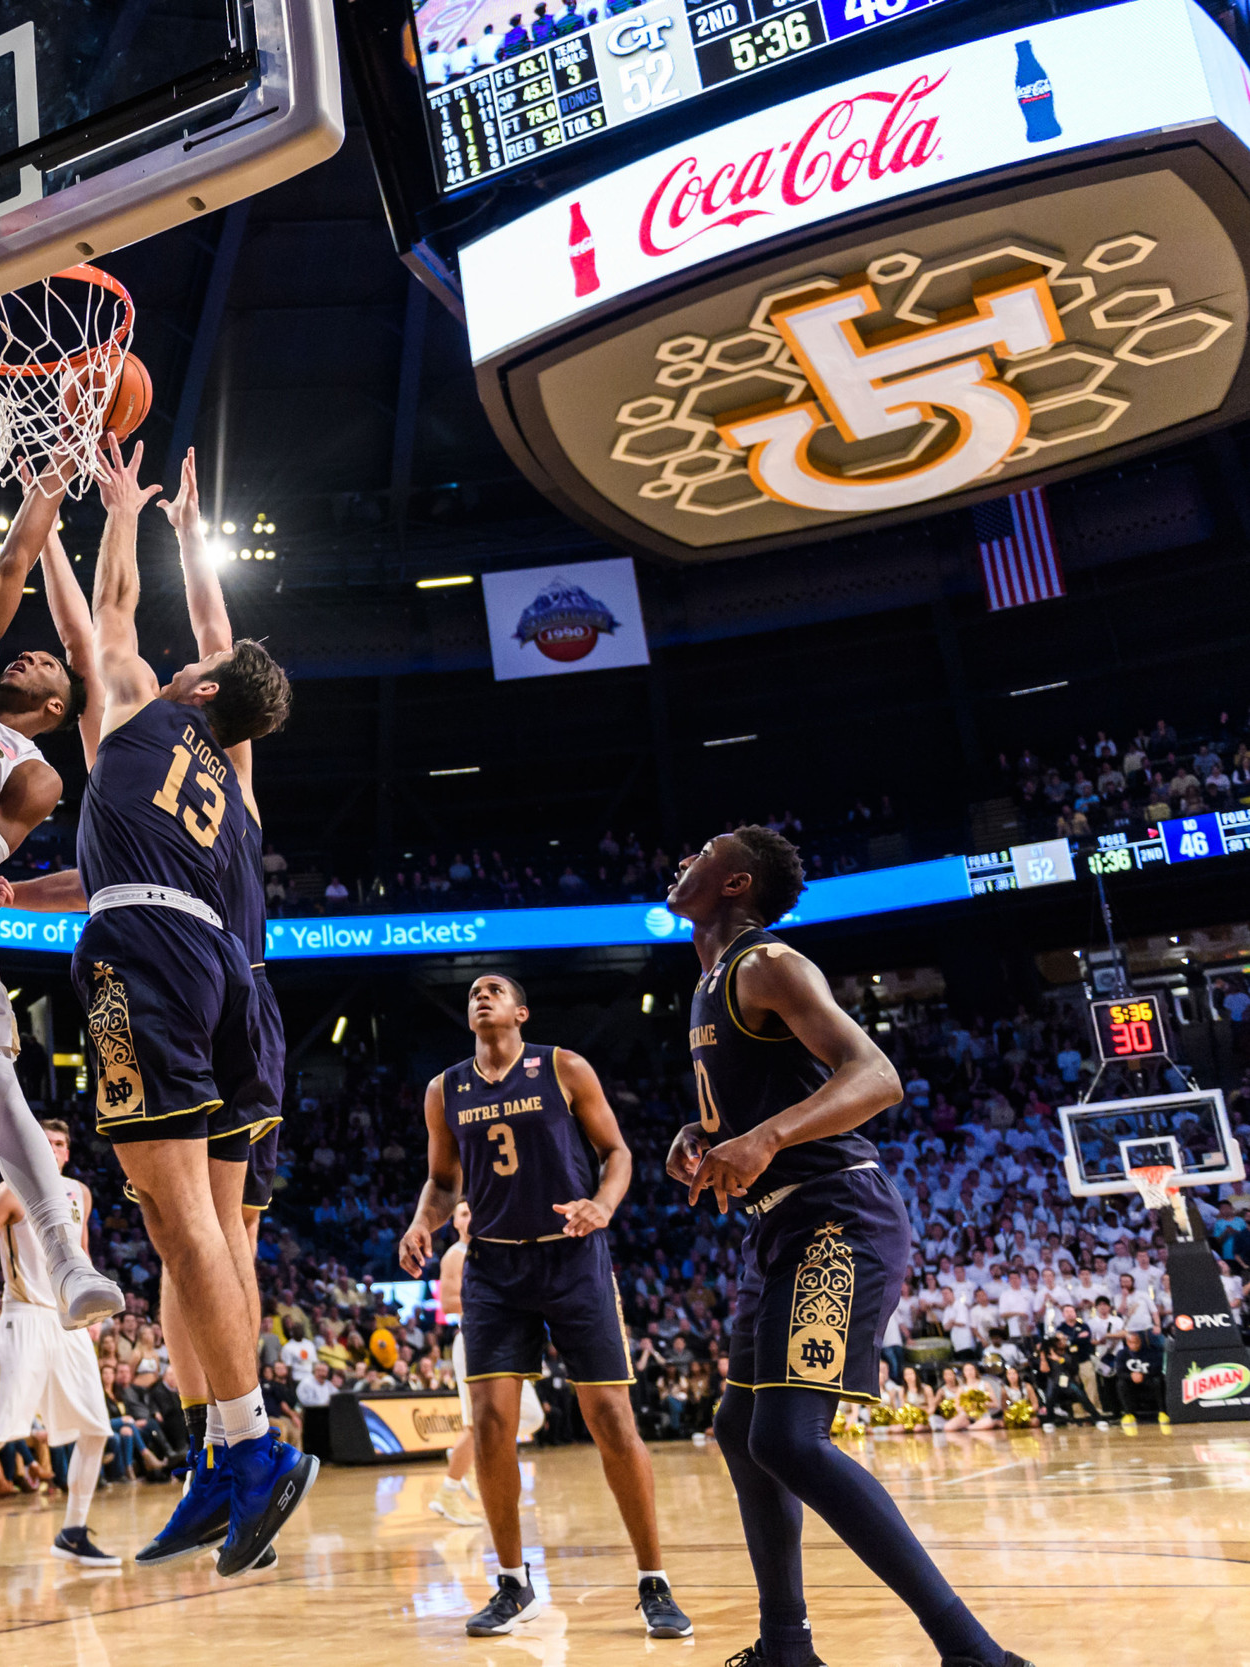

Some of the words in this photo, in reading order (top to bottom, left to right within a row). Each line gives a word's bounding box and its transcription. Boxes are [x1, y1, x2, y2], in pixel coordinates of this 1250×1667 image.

[607, 15, 673, 57] GT
[695, 4, 738, 37] 2ND
[554, 38, 583, 58] TEAM
[729, 11, 812, 72] 5:36
[494, 67, 516, 88] FG
[518, 54, 548, 79] 43.1
[555, 48, 589, 71] FOULS
[566, 64, 582, 86] 3
[431, 92, 450, 110] PLR
[469, 76, 490, 95] PTS
[522, 77, 553, 102] 45.5
[619, 50, 681, 115] 52
[440, 106, 450, 121] 1
[459, 98, 469, 113] 1
[475, 88, 493, 107] 11
[441, 121, 454, 138] 5
[461, 112, 473, 130] 0
[478, 104, 496, 123] 11
[502, 116, 522, 137] FT
[526, 102, 557, 126] 75.0
[591, 110, 604, 128] 3
[442, 135, 460, 154] 10
[464, 128, 475, 145] 1
[483, 120, 496, 137] 6
[444, 151, 463, 169] 13
[466, 144, 479, 161] 2
[486, 136, 498, 153] 3
[506, 136, 537, 161] REB
[542, 127, 562, 146] 32
[446, 166, 465, 184] 44
[469, 159, 482, 176] 2
[488, 152, 501, 168] 8
[639, 67, 951, 257] Coca-Cola
[182, 724, 227, 784] DJOGO
[152, 744, 226, 848] 13
[1182, 818, 1198, 832] ND
[1140, 847, 1164, 862] 2ND
[1179, 832, 1209, 857] 46
[1027, 857, 1057, 883] 52
[43, 919, 68, 943] of
[291, 924, 373, 949] Yellow
[1110, 1002, 1153, 1024] 5:36
[1110, 1021, 1153, 1055] 30
[458, 1104, 500, 1126] NOTRE
[503, 1096, 543, 1116] DAME
[487, 1122, 519, 1177] 3
[1192, 1313, 1232, 1329] PNC
[1181, 1367, 1245, 1405] LIBMAN
